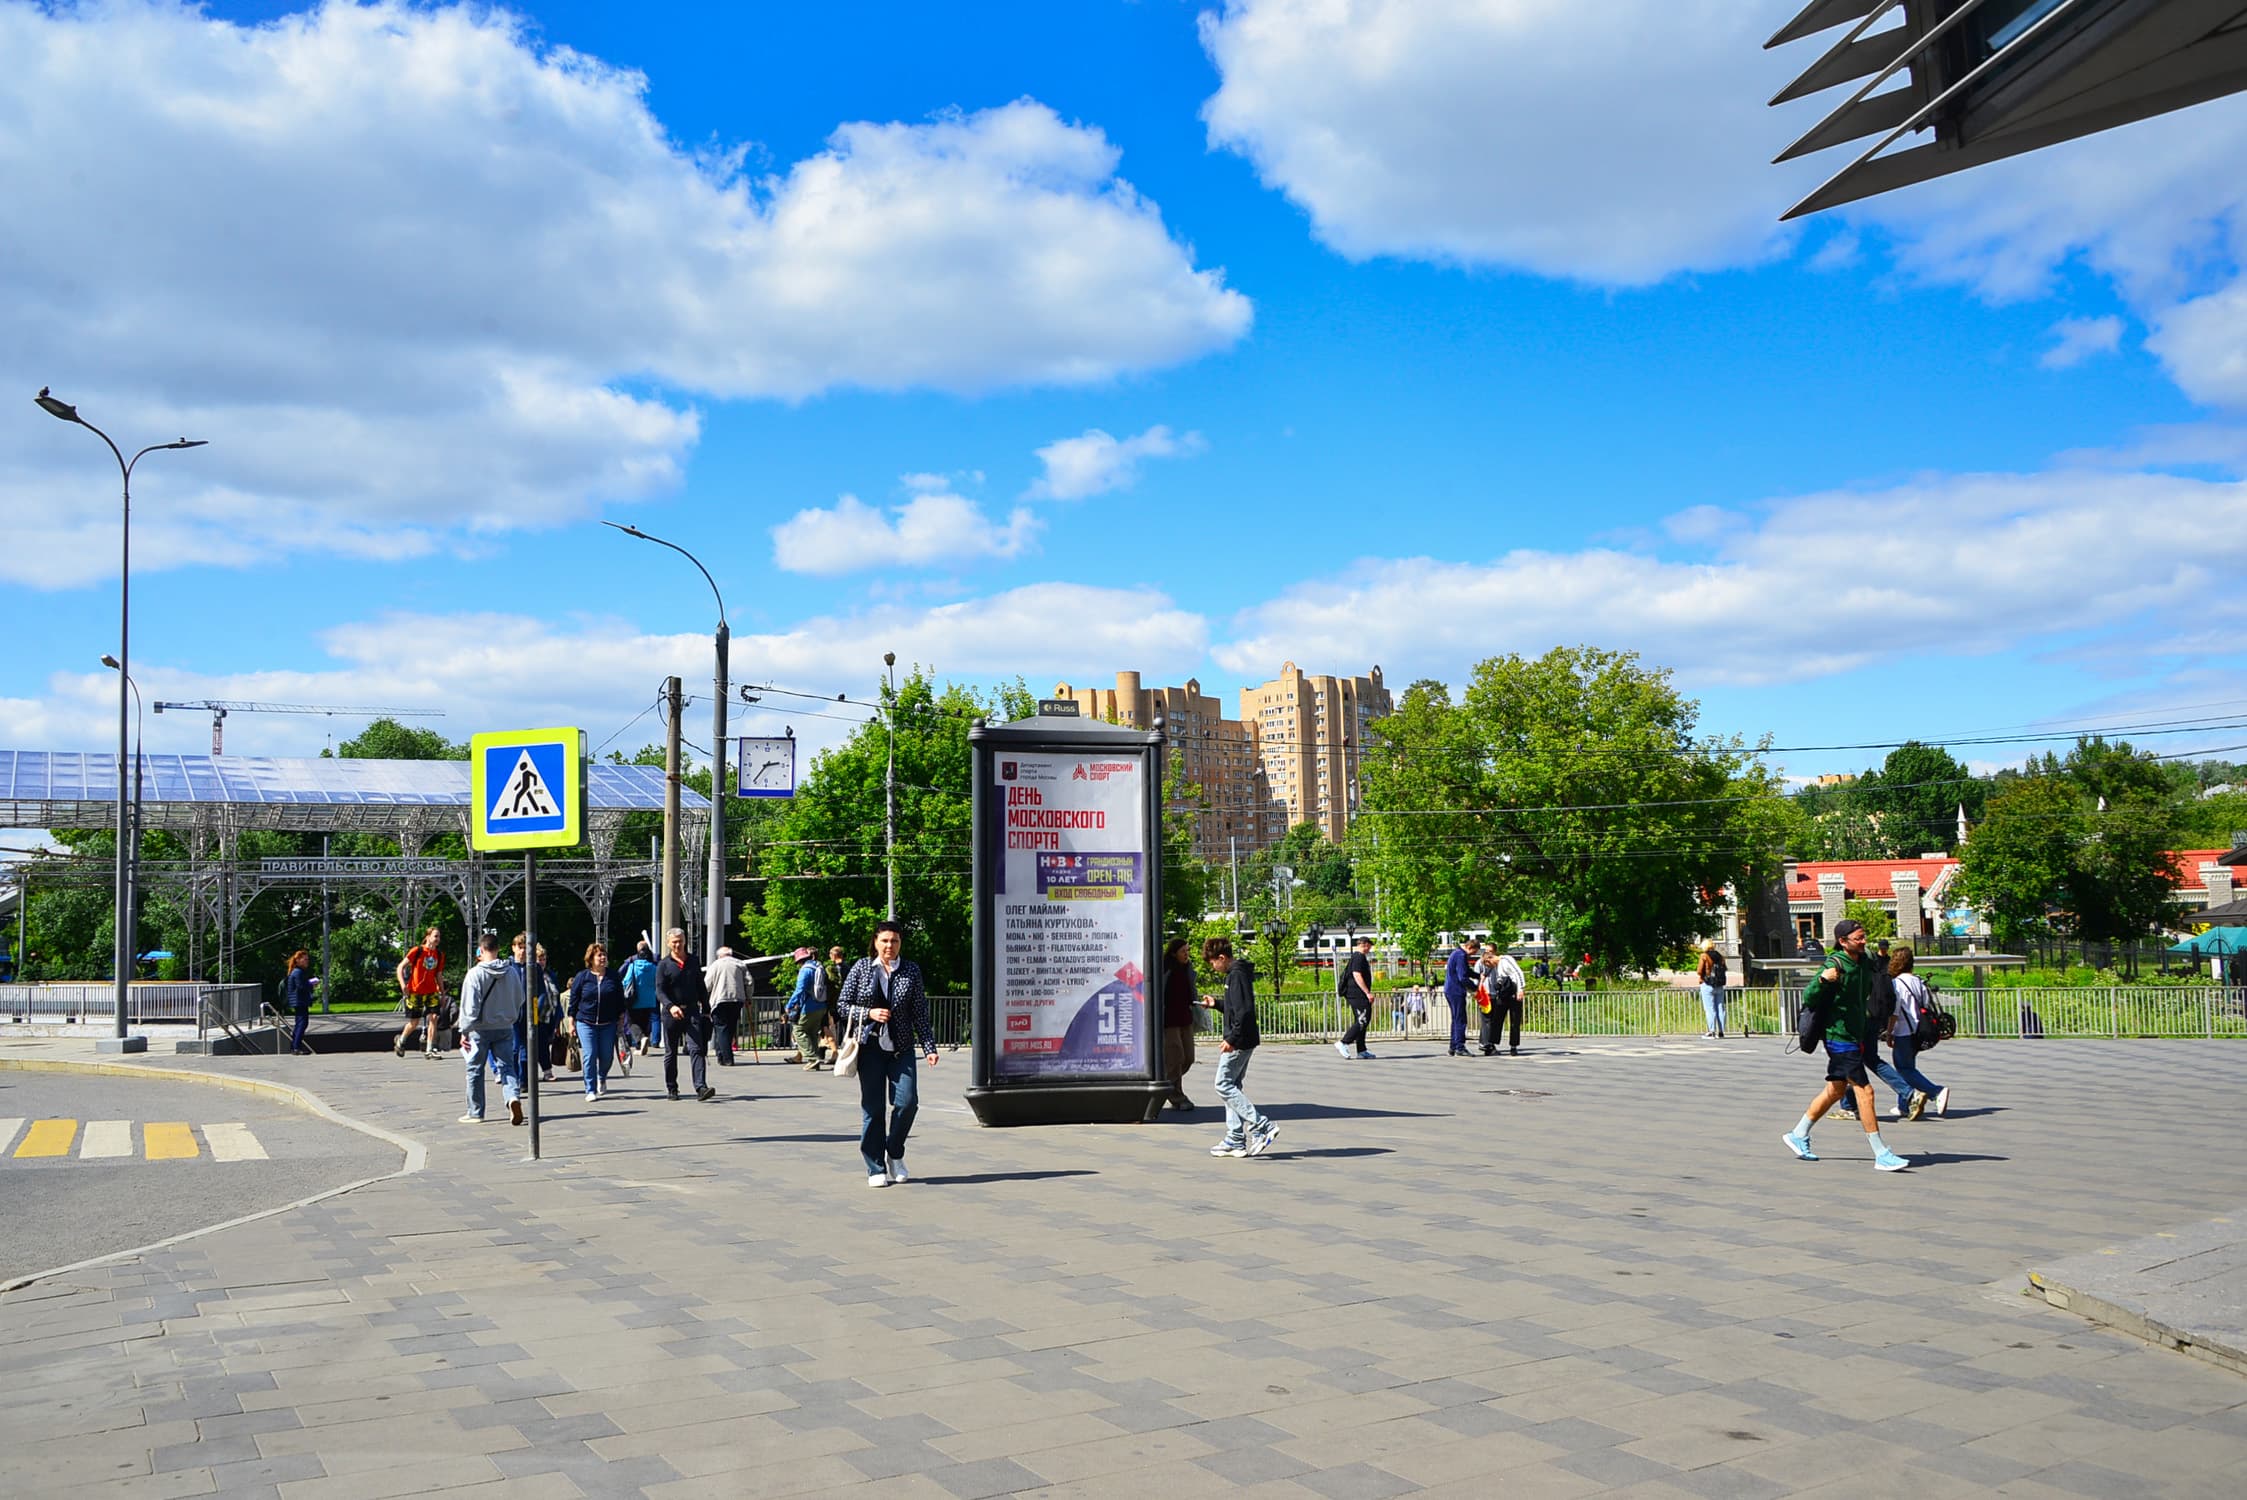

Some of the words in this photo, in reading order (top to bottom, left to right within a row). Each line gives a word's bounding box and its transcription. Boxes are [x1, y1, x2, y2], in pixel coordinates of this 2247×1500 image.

[1053, 703, 1076, 712] Russ
[1090, 762, 1132, 772] МОСКОВСКИЙ
[1008, 786, 1042, 806] ДЕНЬ
[1008, 809, 1104, 828] МОСКОВСКОГО
[1008, 831, 1059, 850] СПОРТА
[261, 861, 380, 872] ПРАВИТЕЛЬСТВО
[384, 861, 446, 872] МОСКВЫ
[1087, 869, 1134, 883] OPEN-AIR
[1054, 888, 1073, 898] ВХОД
[1074, 887, 1117, 898] СВОБОДНЫЙ
[1006, 905, 1028, 915] ОЛЕГ
[1029, 904, 1066, 915] МАЙАМИ
[1006, 918, 1043, 929] ТАТЬЯНА
[1045, 918, 1094, 928] КУРТУКОВА
[1051, 932, 1082, 940] SEREBRO
[1006, 944, 1032, 952] БЬЯНКА
[1051, 944, 1103, 952] FILATOV&KARAS
[1026, 956, 1047, 964] ELMAN
[1070, 966, 1101, 975] AMIRCHIK
[1006, 978, 1036, 986] ЗВОНКИЙ
[1098, 993, 1115, 1034] 5
[1118, 993, 1133, 1044] ЛУЖНИКИ
[1097, 1034, 1117, 1044] ИЮЛЯ
